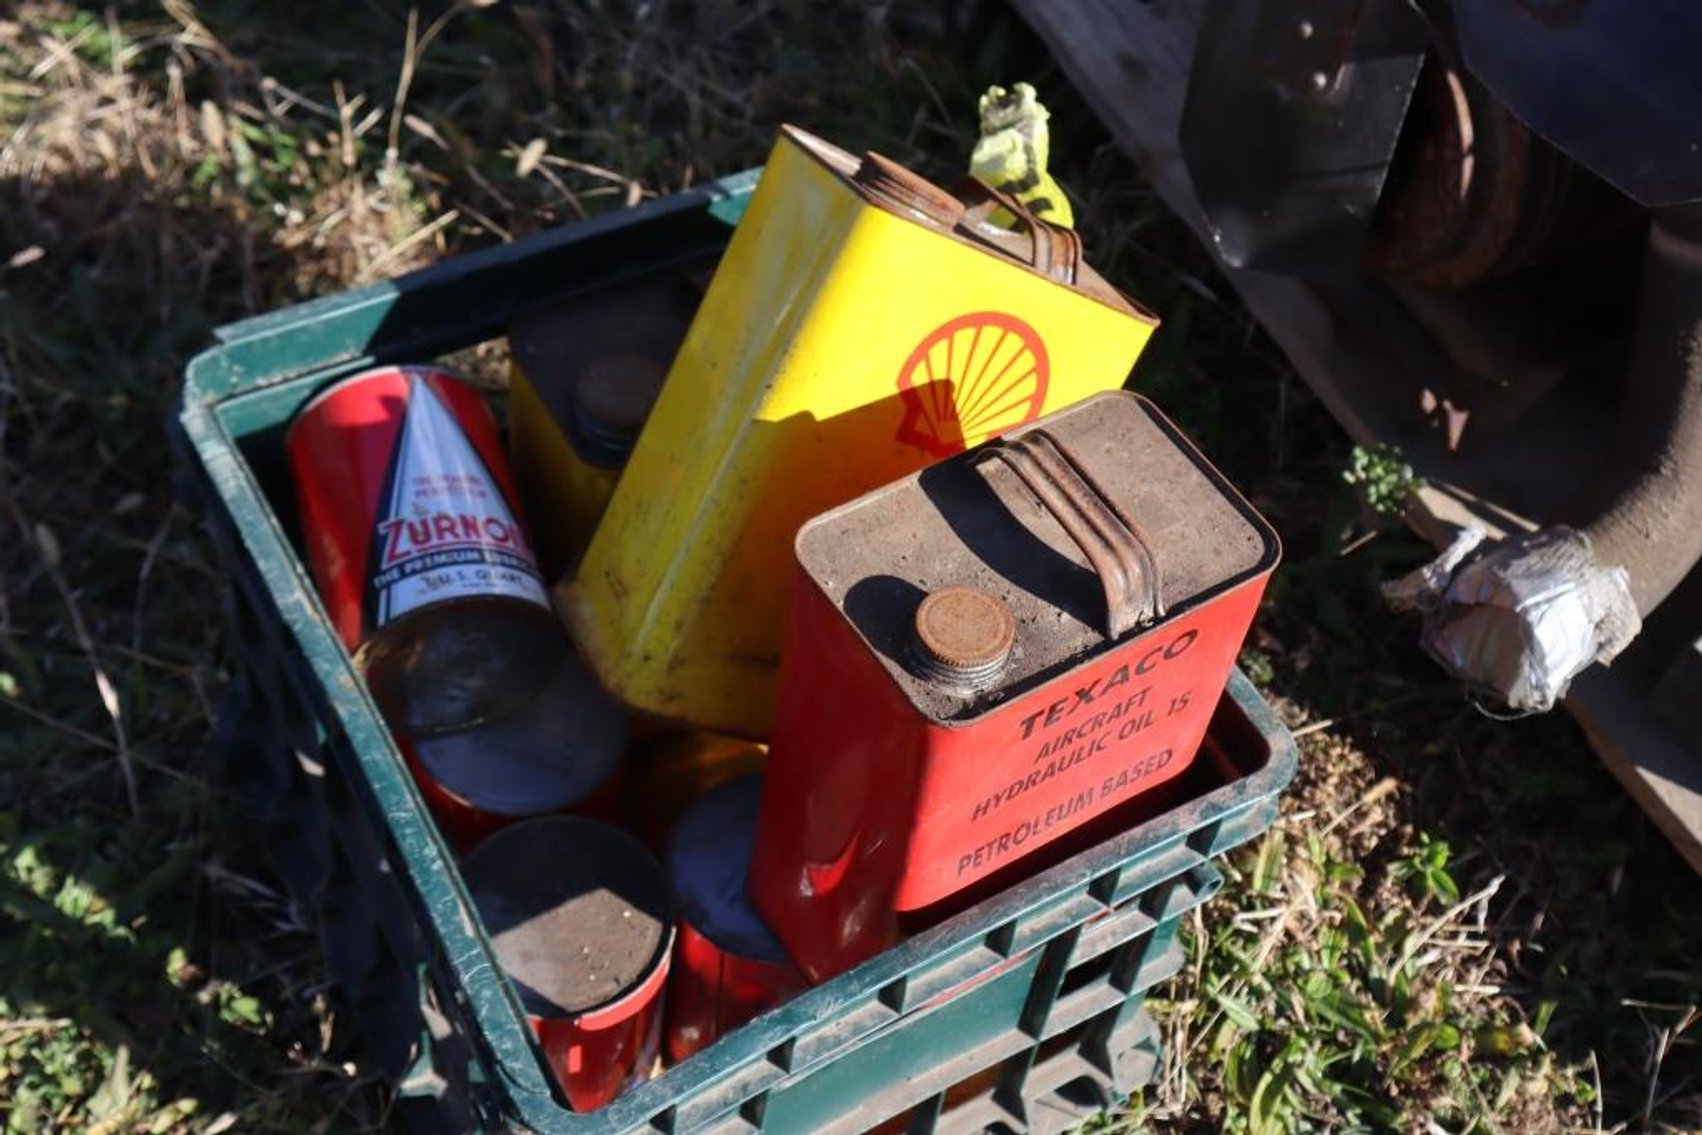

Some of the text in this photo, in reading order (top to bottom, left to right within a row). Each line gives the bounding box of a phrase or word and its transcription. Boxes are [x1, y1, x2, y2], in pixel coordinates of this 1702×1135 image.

[1020, 628, 1198, 741] TEXACO
[1034, 687, 1153, 764] AIRCRAFT
[957, 748, 1173, 878] PETROLEUM BASED
[971, 731, 1115, 822] HYDRAULIC
[1118, 710, 1155, 741] OIL
